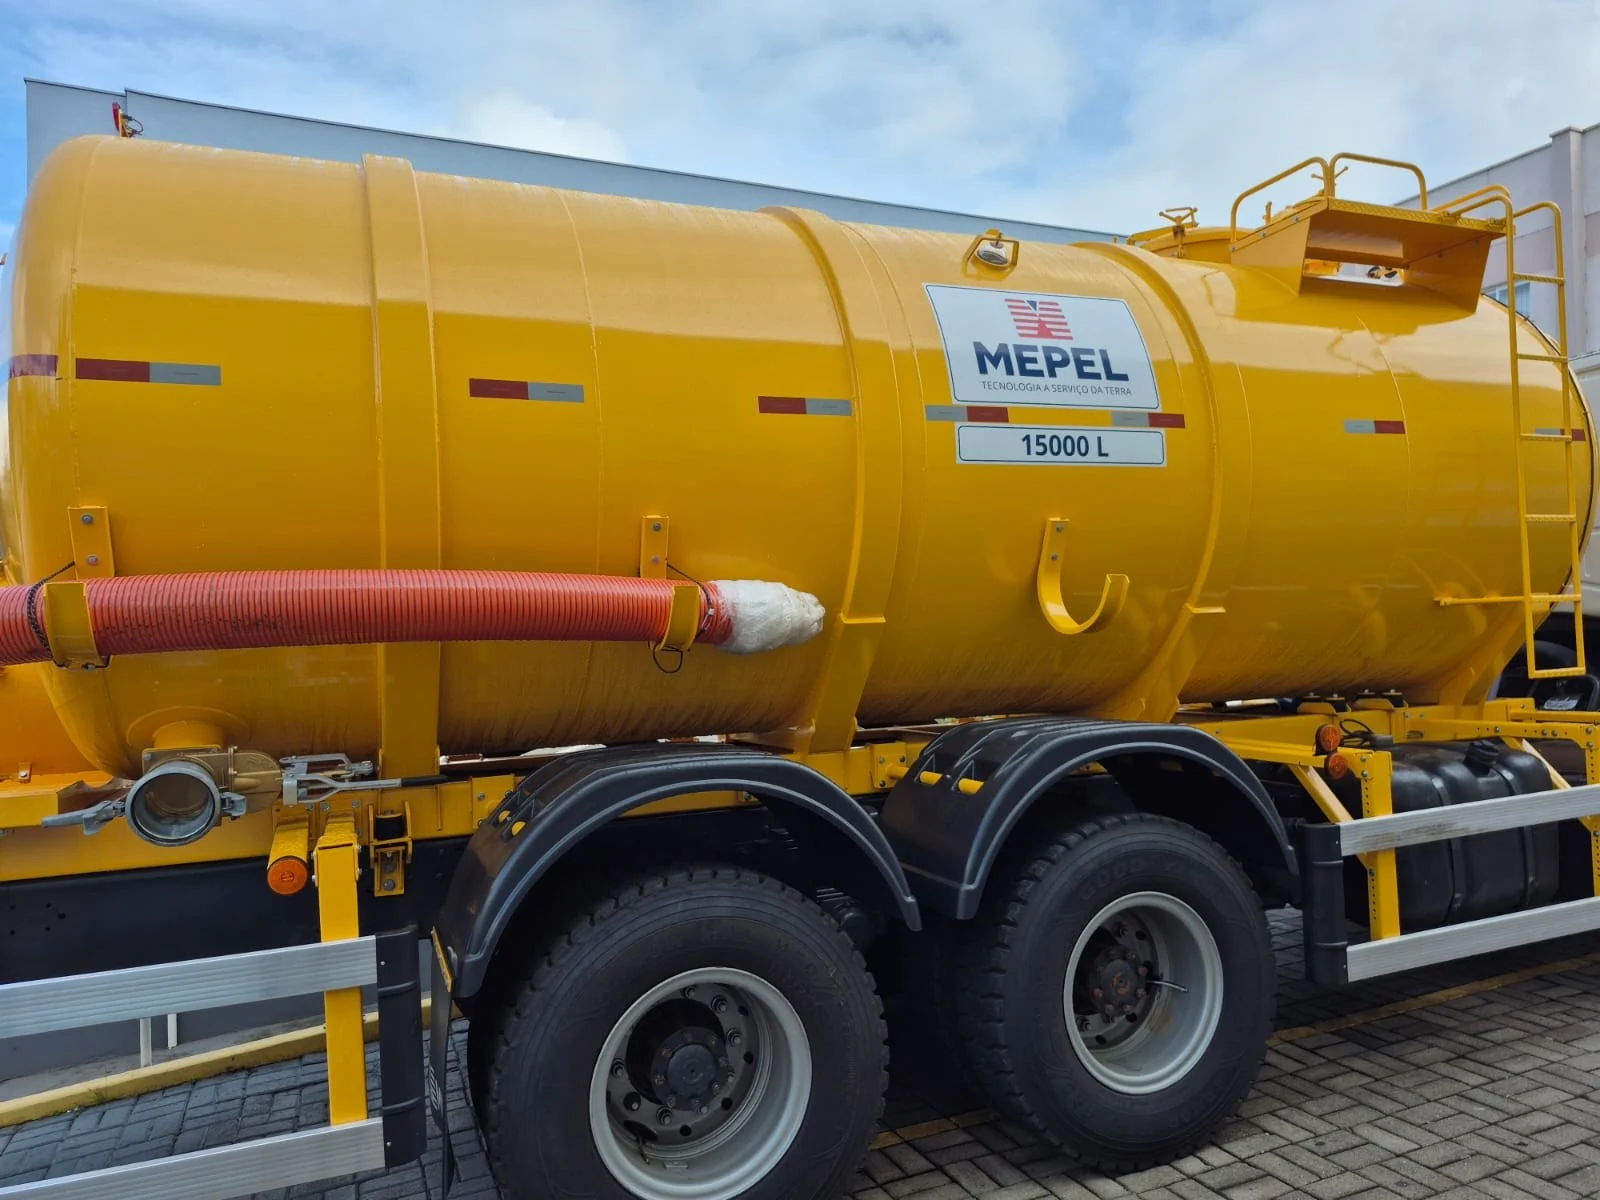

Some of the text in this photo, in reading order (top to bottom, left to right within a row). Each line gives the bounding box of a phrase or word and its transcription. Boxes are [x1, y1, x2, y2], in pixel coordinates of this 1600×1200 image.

[973, 341, 1129, 381] MEPEL
[982, 380, 1132, 396] TECNOLOGIA A SERVIÇO DA TERRA
[1021, 434, 1109, 457] 15000 L
